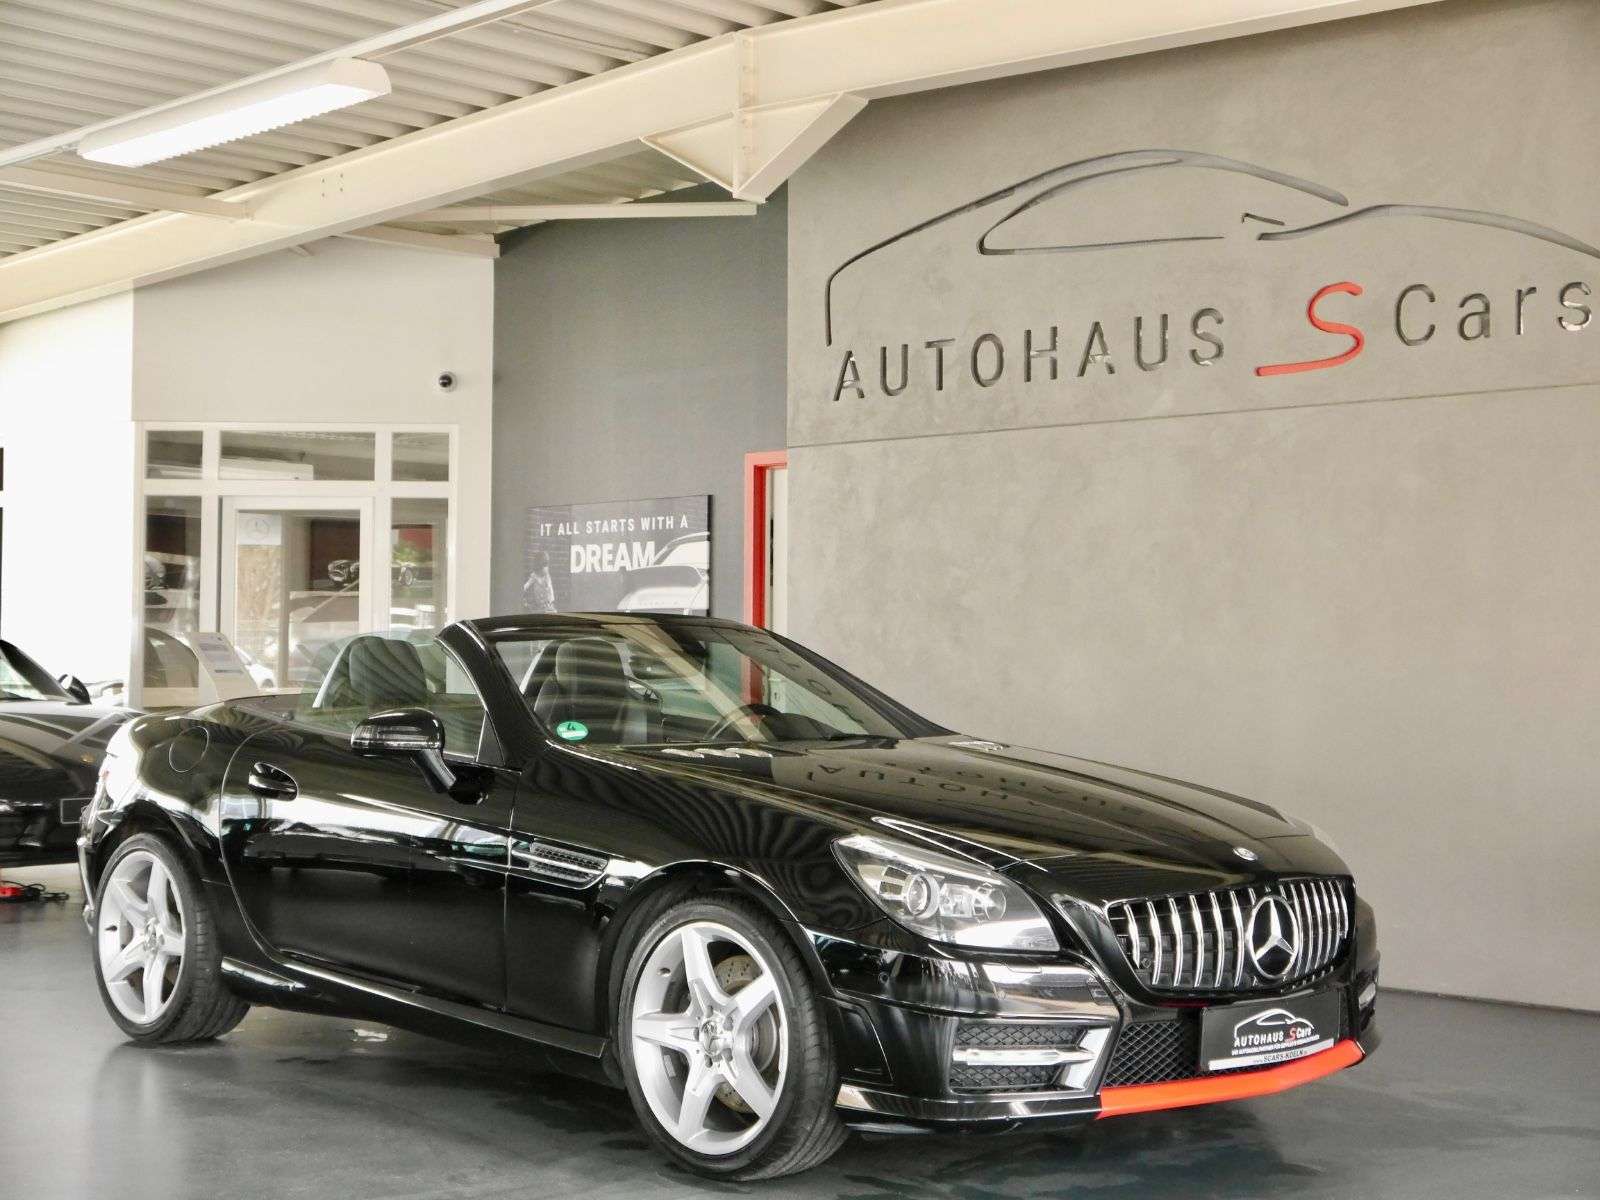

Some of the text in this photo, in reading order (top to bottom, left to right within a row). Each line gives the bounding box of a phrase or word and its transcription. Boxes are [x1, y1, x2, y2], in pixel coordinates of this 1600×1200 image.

[833, 282, 1593, 401] AUTOHAUS S Cars
[540, 514, 688, 536] IT ALL STARTS WITH A
[570, 541, 656, 573] DREAM
[1234, 1031, 1283, 1047] AUTOHAUS
